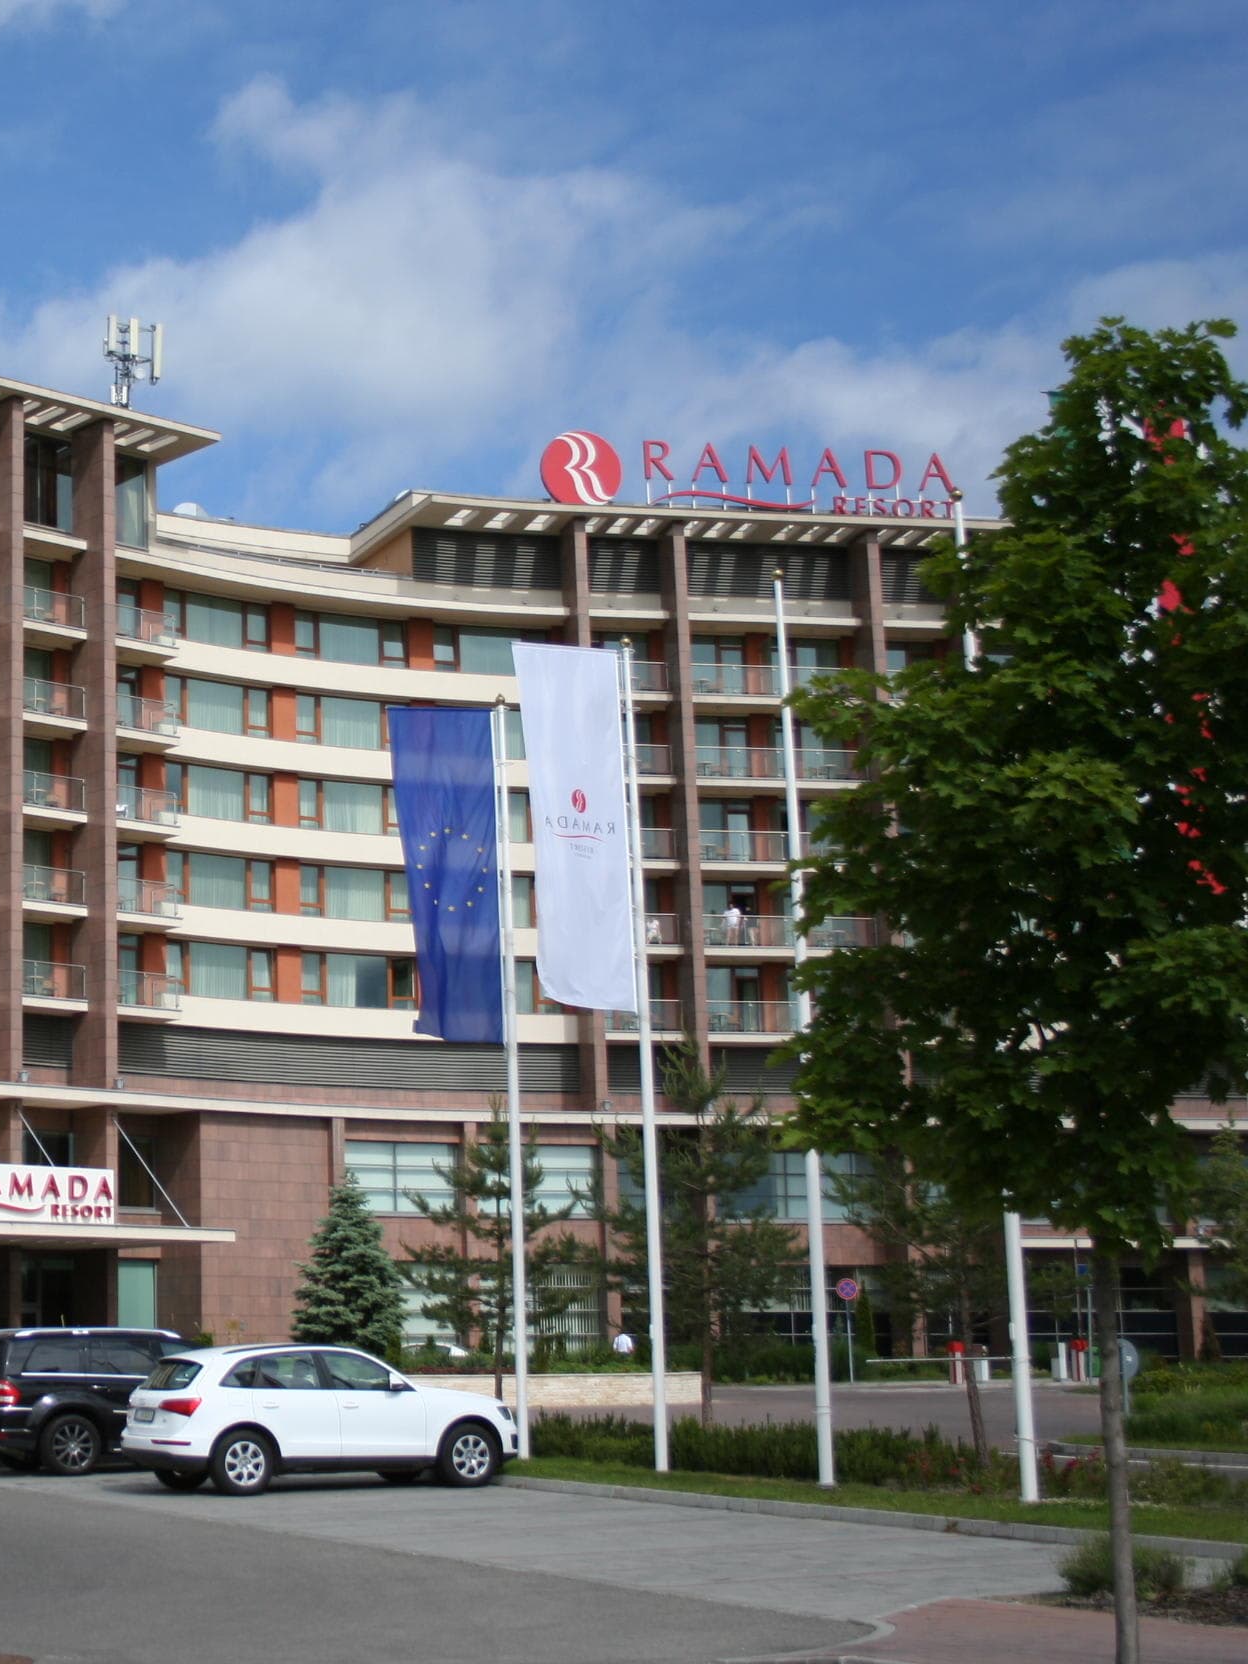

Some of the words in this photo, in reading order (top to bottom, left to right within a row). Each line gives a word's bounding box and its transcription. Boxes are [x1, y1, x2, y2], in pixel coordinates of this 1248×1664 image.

[643, 439, 956, 492] RAMADA
[833, 496, 954, 519] RESORT
[52, 1204, 113, 1219] RESORT
